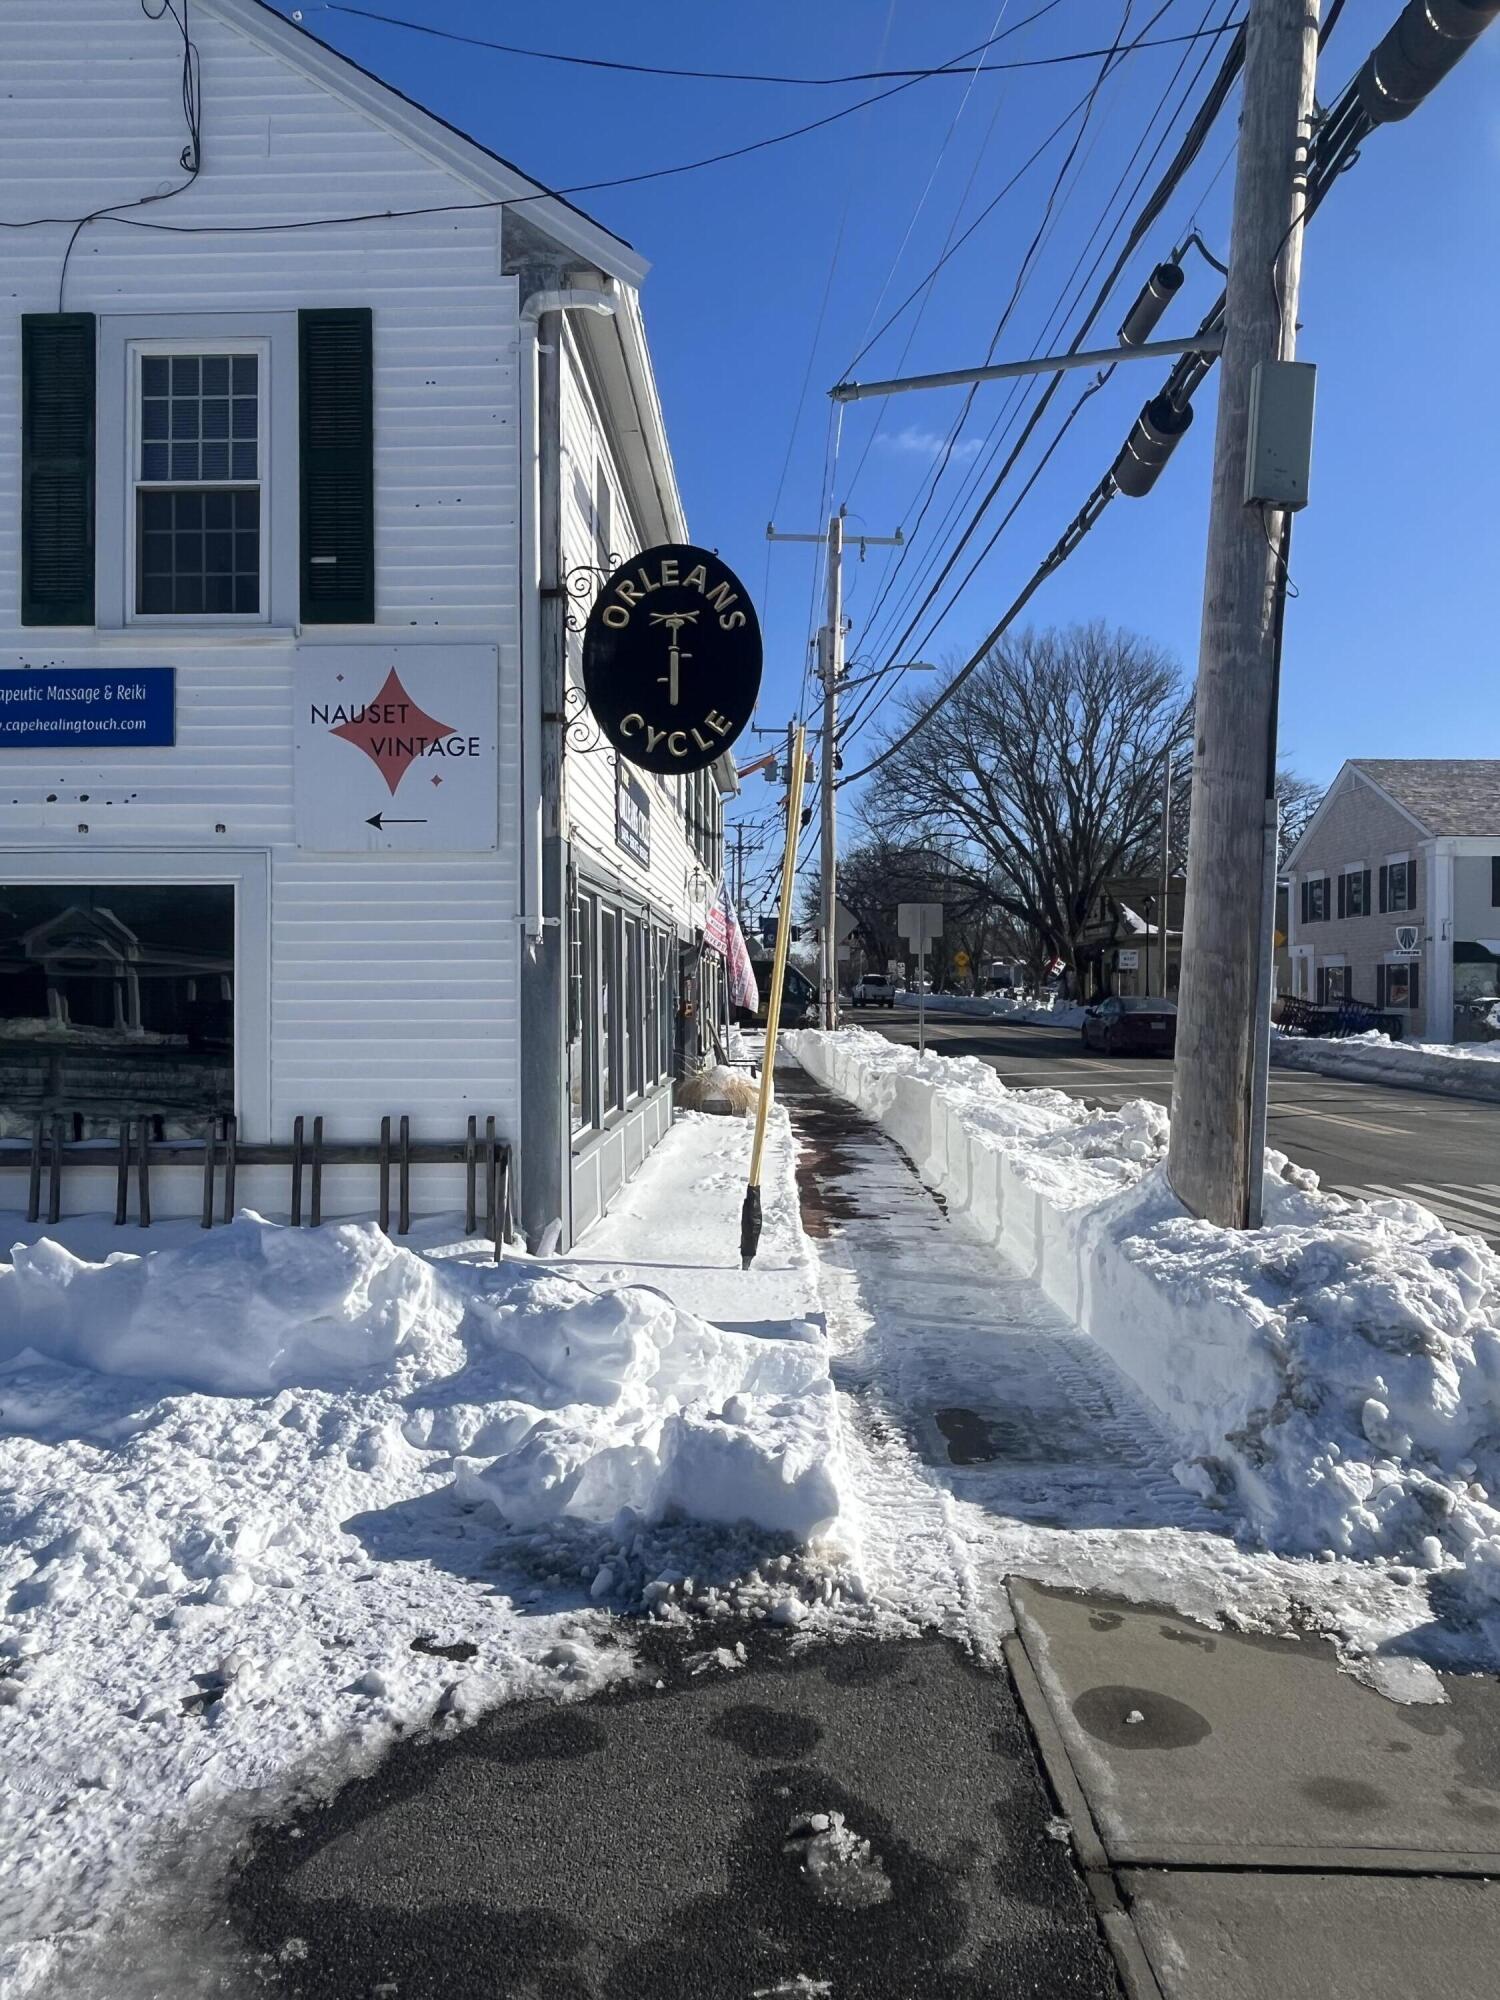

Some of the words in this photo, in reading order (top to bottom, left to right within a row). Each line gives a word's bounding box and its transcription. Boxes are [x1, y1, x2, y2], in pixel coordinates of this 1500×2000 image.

[602, 560, 746, 631] ORLEANS
[47, 685, 100, 704] Massage
[104, 684, 113, 700] &
[117, 684, 146, 700] Reiki
[311, 704, 409, 724] NAUSET
[619, 709, 733, 757] CYCLE
[370, 737, 480, 757] VINTAGE
